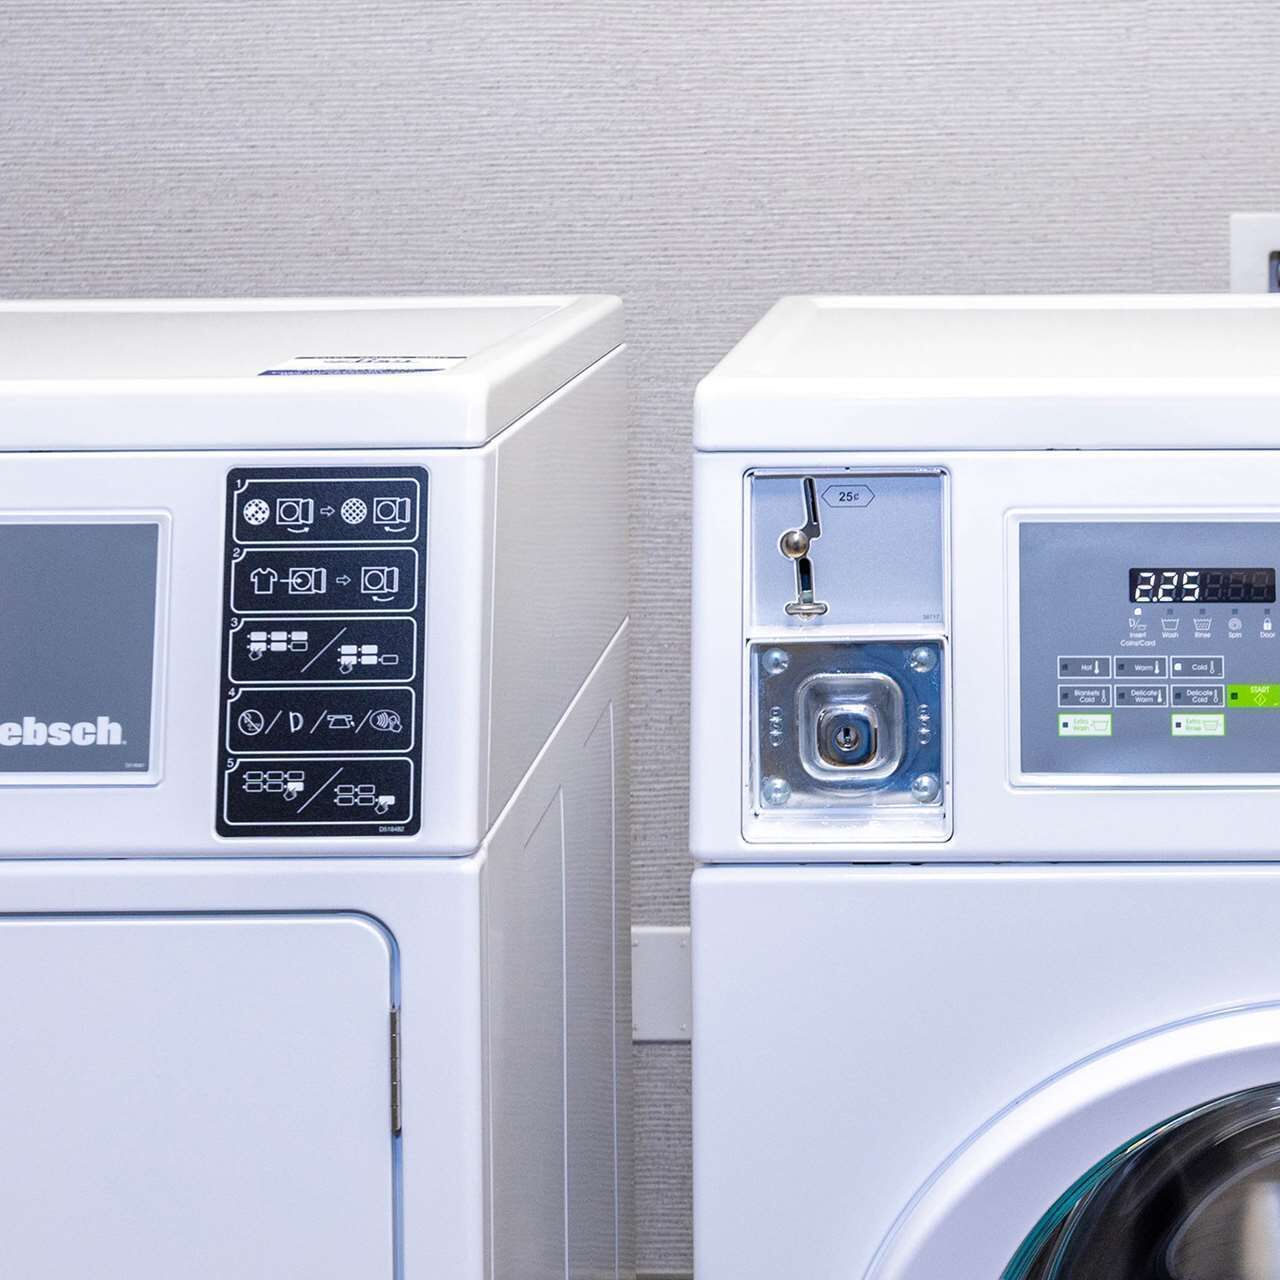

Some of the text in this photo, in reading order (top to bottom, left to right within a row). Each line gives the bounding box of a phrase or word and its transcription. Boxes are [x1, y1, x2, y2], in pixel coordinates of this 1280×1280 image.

[235, 479, 242, 488] 1
[839, 491, 859, 502] 25¢
[232, 548, 240, 557] 2
[1135, 571, 1200, 602] 2.25
[230, 617, 238, 627] 3
[1228, 631, 1242, 639] Spin
[1191, 663, 1208, 671] Cold
[228, 687, 235, 696] 4
[226, 759, 234, 768] 5
